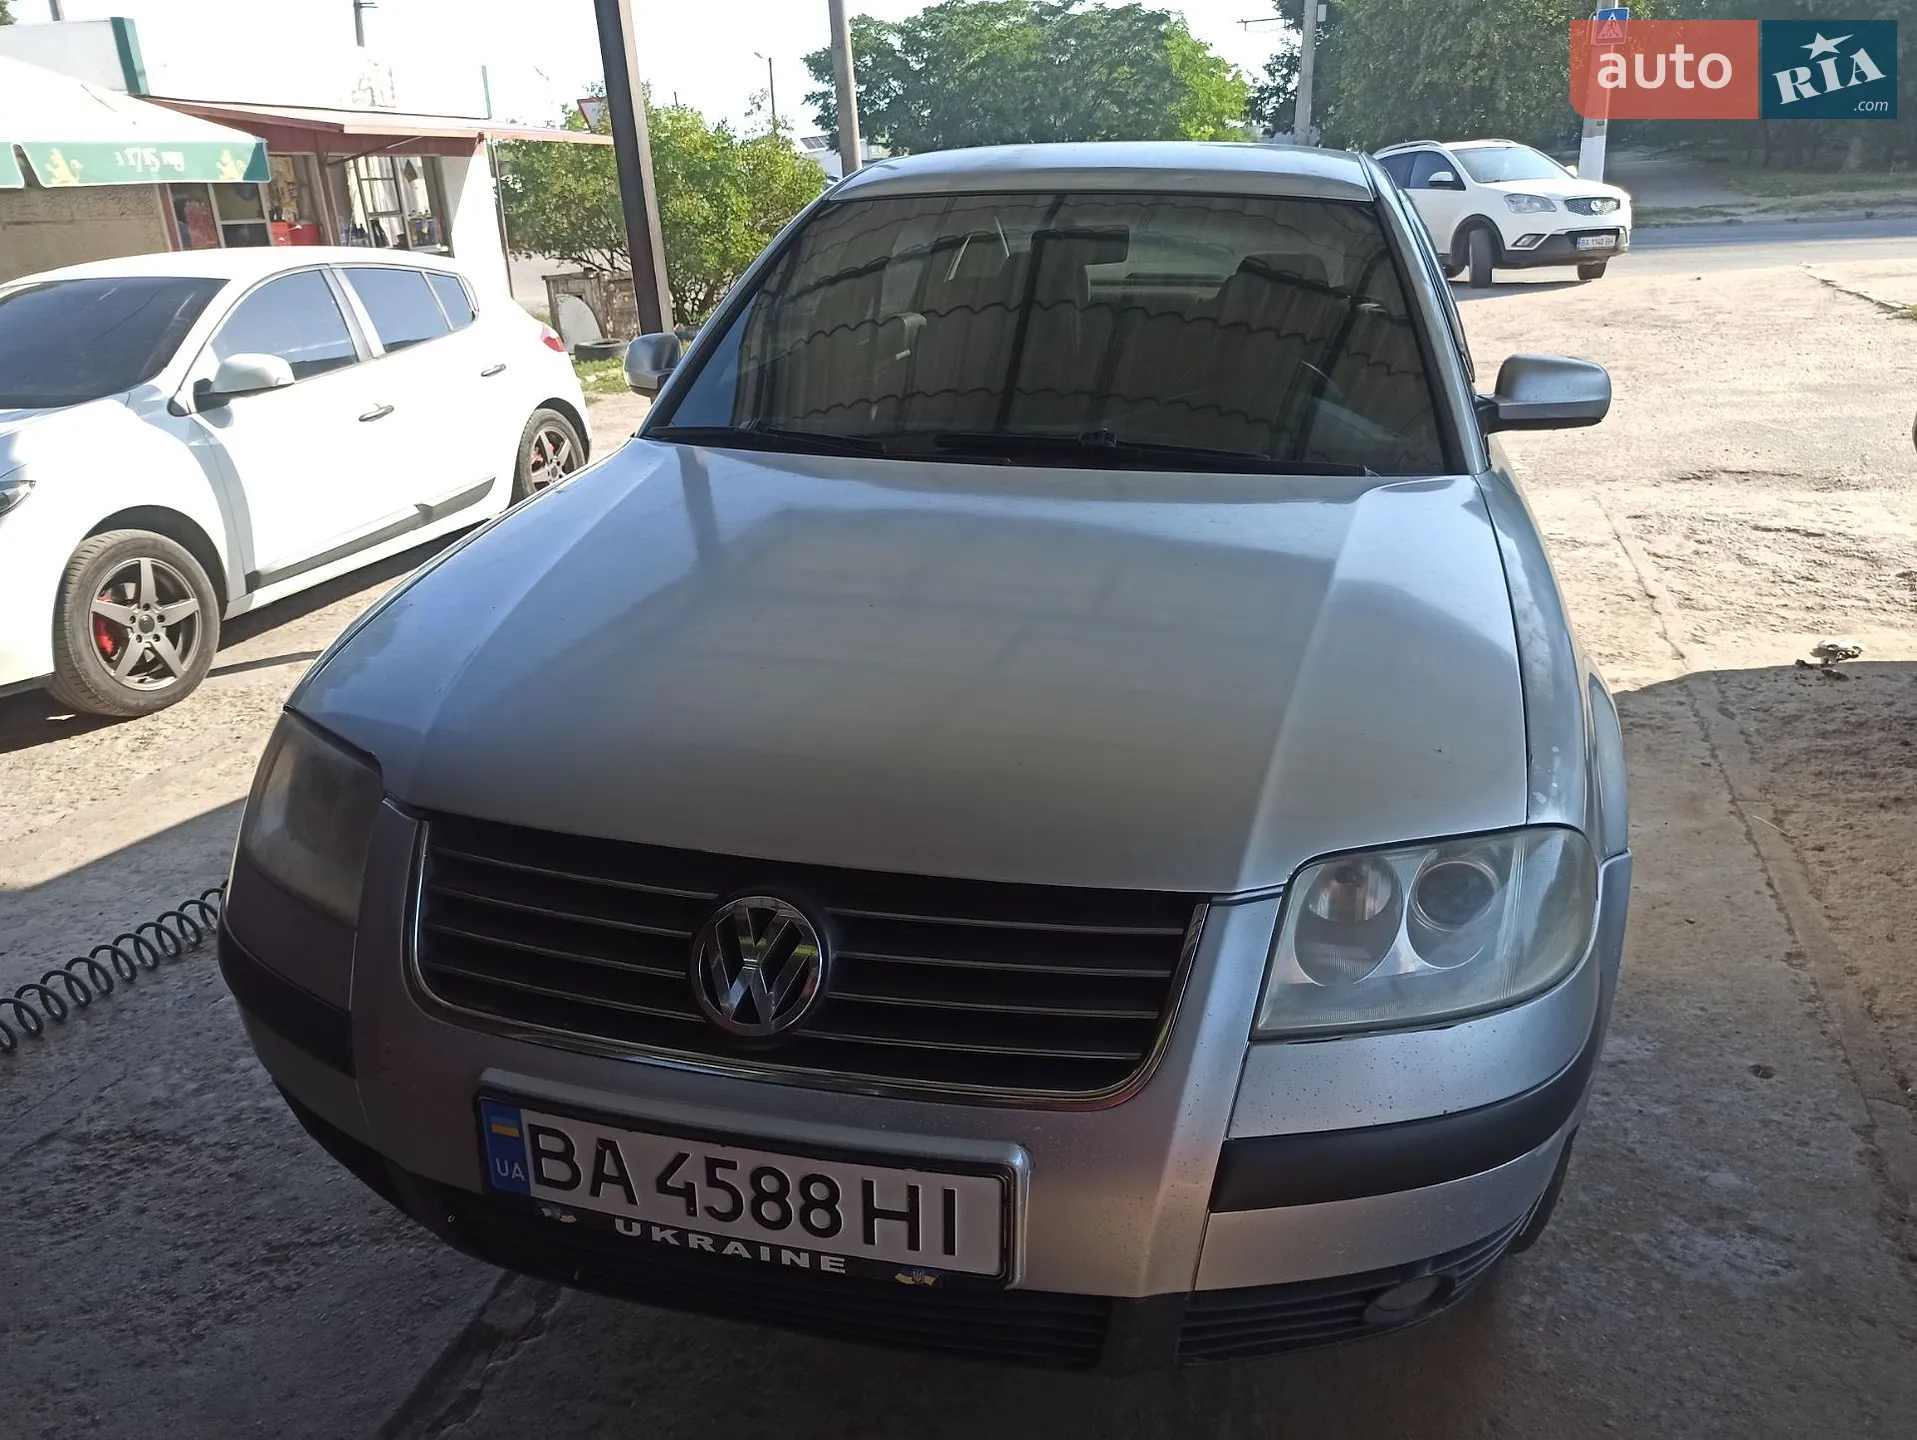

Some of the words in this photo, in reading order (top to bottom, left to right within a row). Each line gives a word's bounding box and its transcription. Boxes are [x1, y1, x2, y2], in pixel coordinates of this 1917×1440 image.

[495, 1158, 526, 1182] UA
[528, 1123, 640, 1206] BA
[655, 1152, 844, 1239] 4588
[862, 1176, 958, 1256] HI
[614, 1217, 846, 1274] UKRAINE
